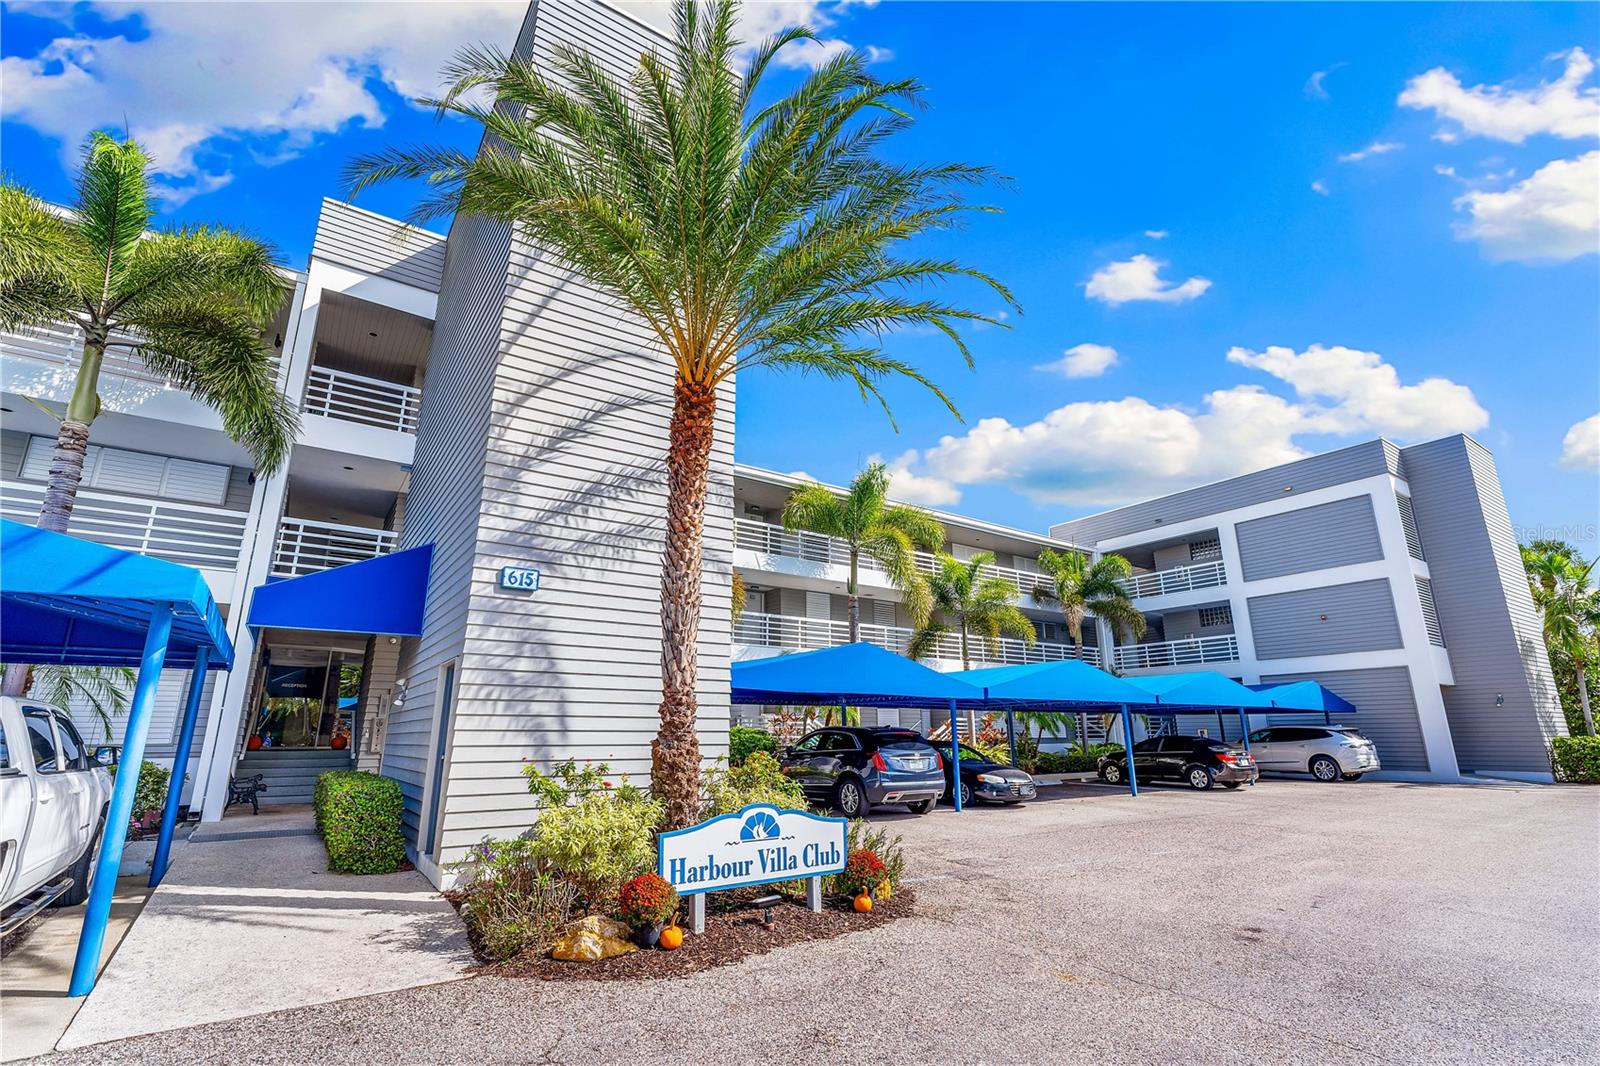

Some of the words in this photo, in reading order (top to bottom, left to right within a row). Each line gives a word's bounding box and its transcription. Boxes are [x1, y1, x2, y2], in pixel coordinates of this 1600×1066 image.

[508, 571, 534, 587] 615
[669, 855, 753, 885] Harbour
[758, 847, 797, 874] Villa
[803, 841, 840, 868] Club
